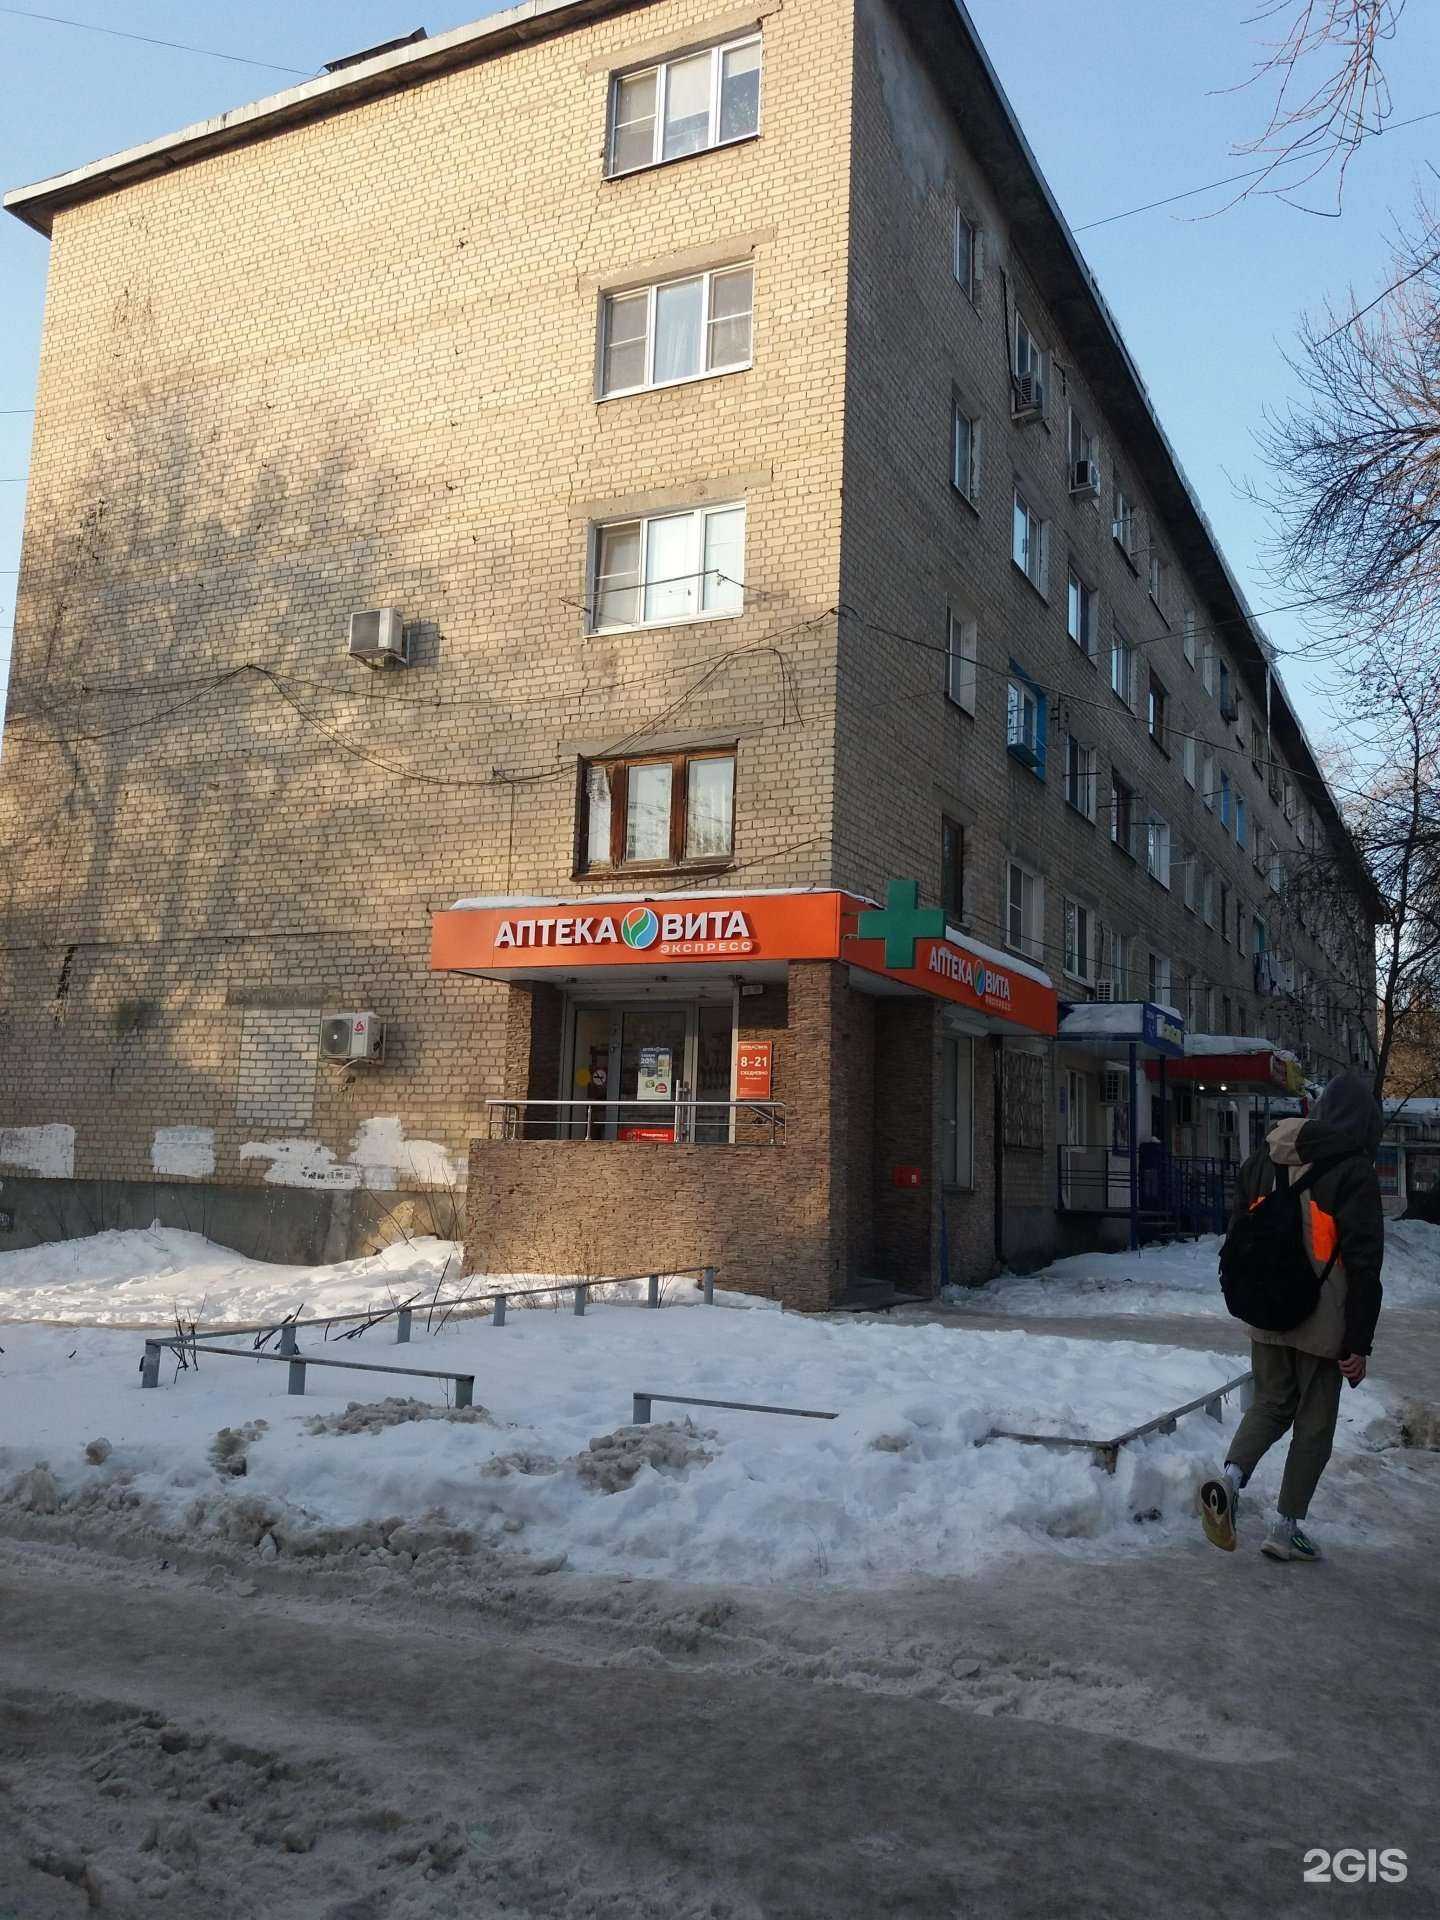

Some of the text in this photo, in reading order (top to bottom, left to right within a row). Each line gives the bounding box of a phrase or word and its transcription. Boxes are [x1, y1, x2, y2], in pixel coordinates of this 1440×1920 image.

[494, 911, 750, 947] АПТЕКА ВИТА
[660, 941, 752, 955] ЭКСПРЕСС
[929, 946, 1010, 1000] АПТЕКА ВИТА
[740, 1056, 767, 1068] 8-21
